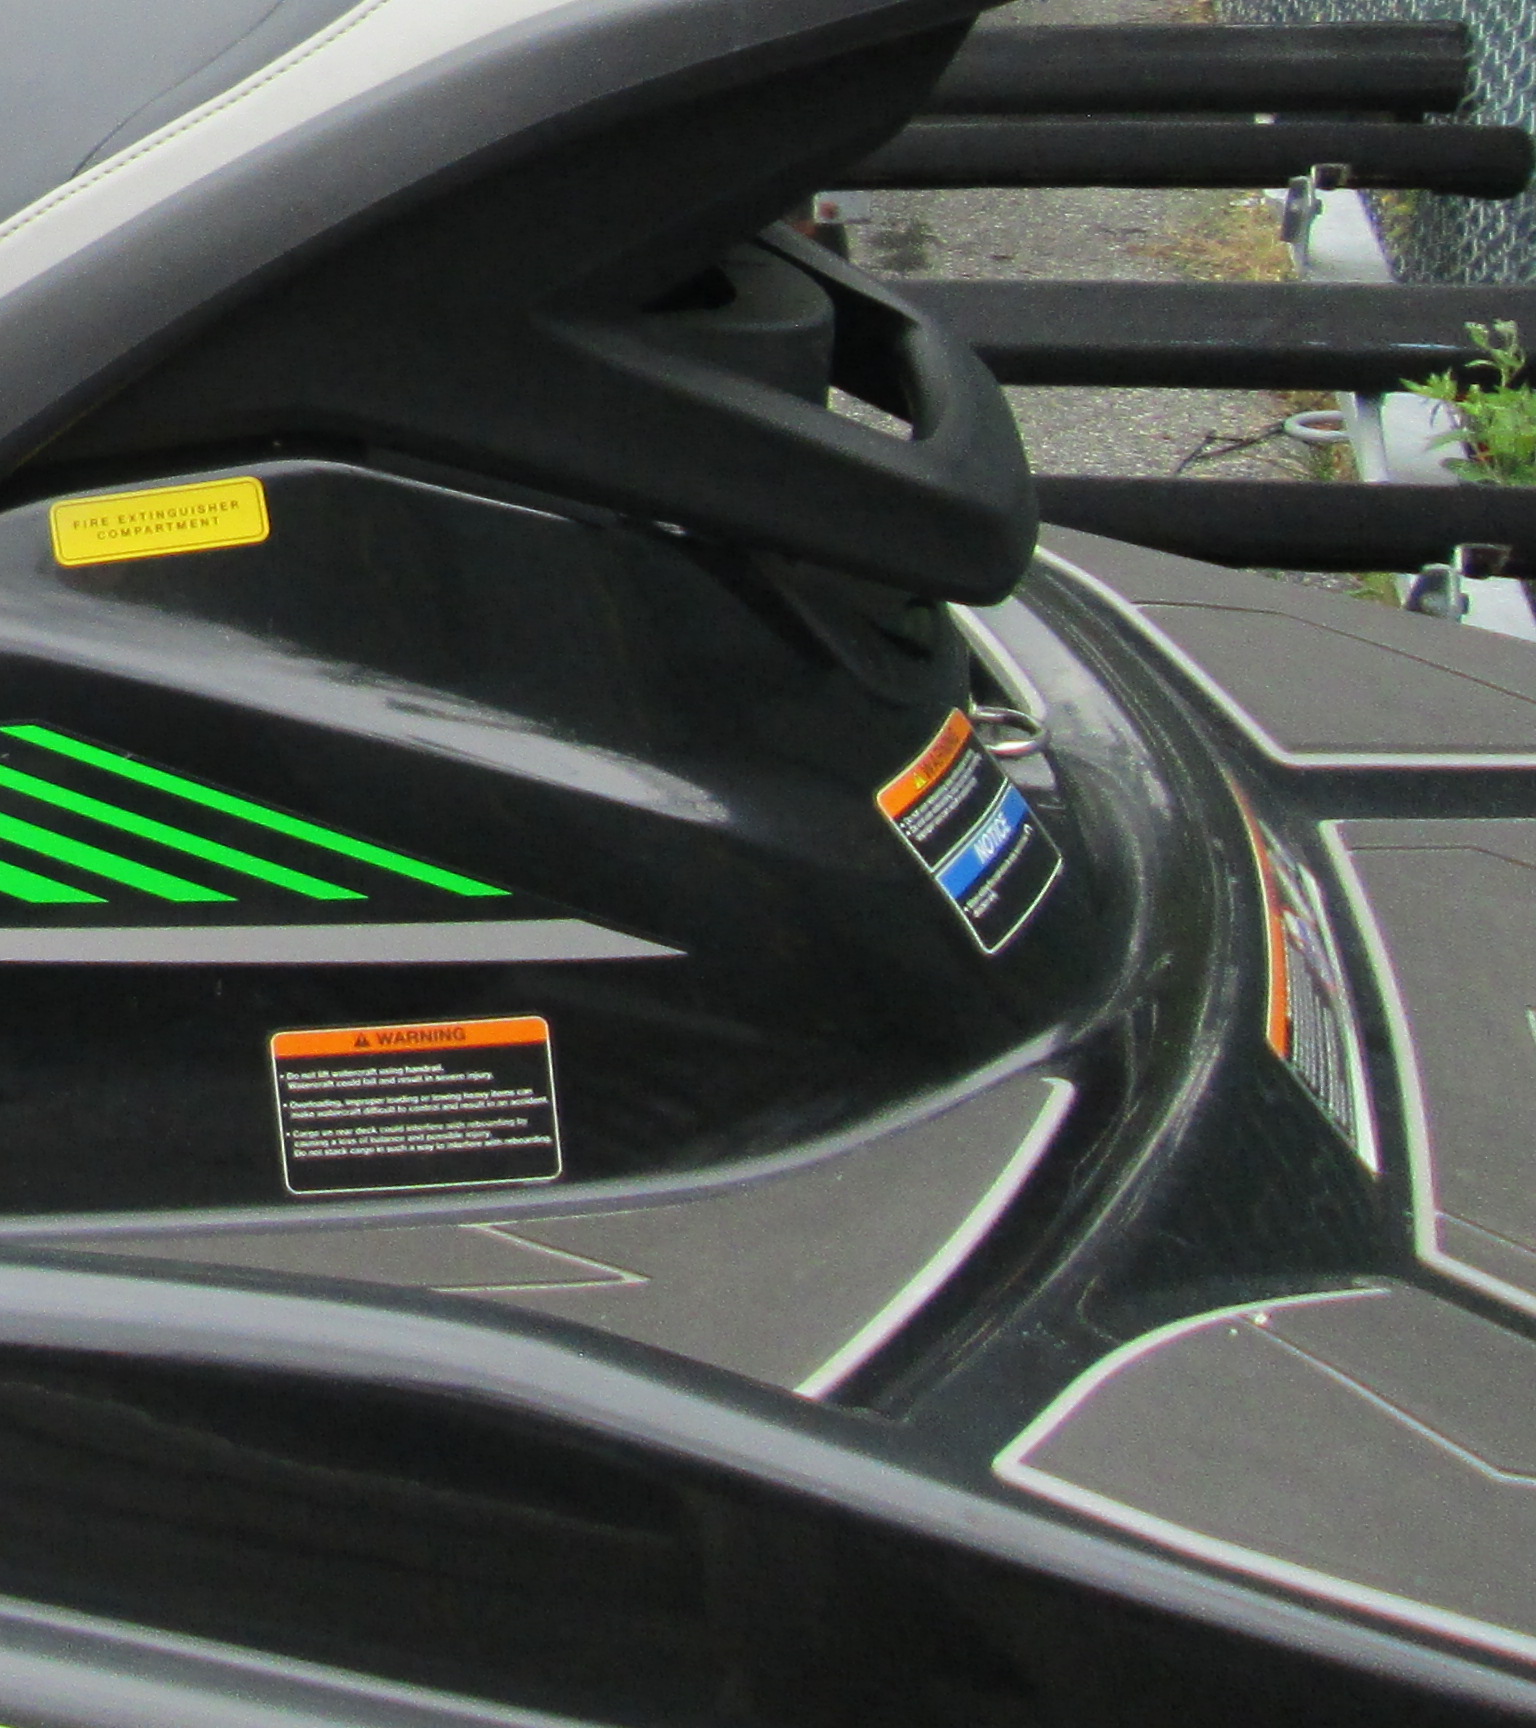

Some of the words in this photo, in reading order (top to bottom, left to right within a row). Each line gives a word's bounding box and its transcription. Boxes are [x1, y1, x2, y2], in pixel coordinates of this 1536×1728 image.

[72, 515, 110, 530] FIRE
[117, 499, 241, 525] EXTINGUISHER
[96, 516, 221, 540] COMPARTMENT
[973, 812, 1012, 864] NOTICE
[376, 1027, 467, 1047] WARNING
